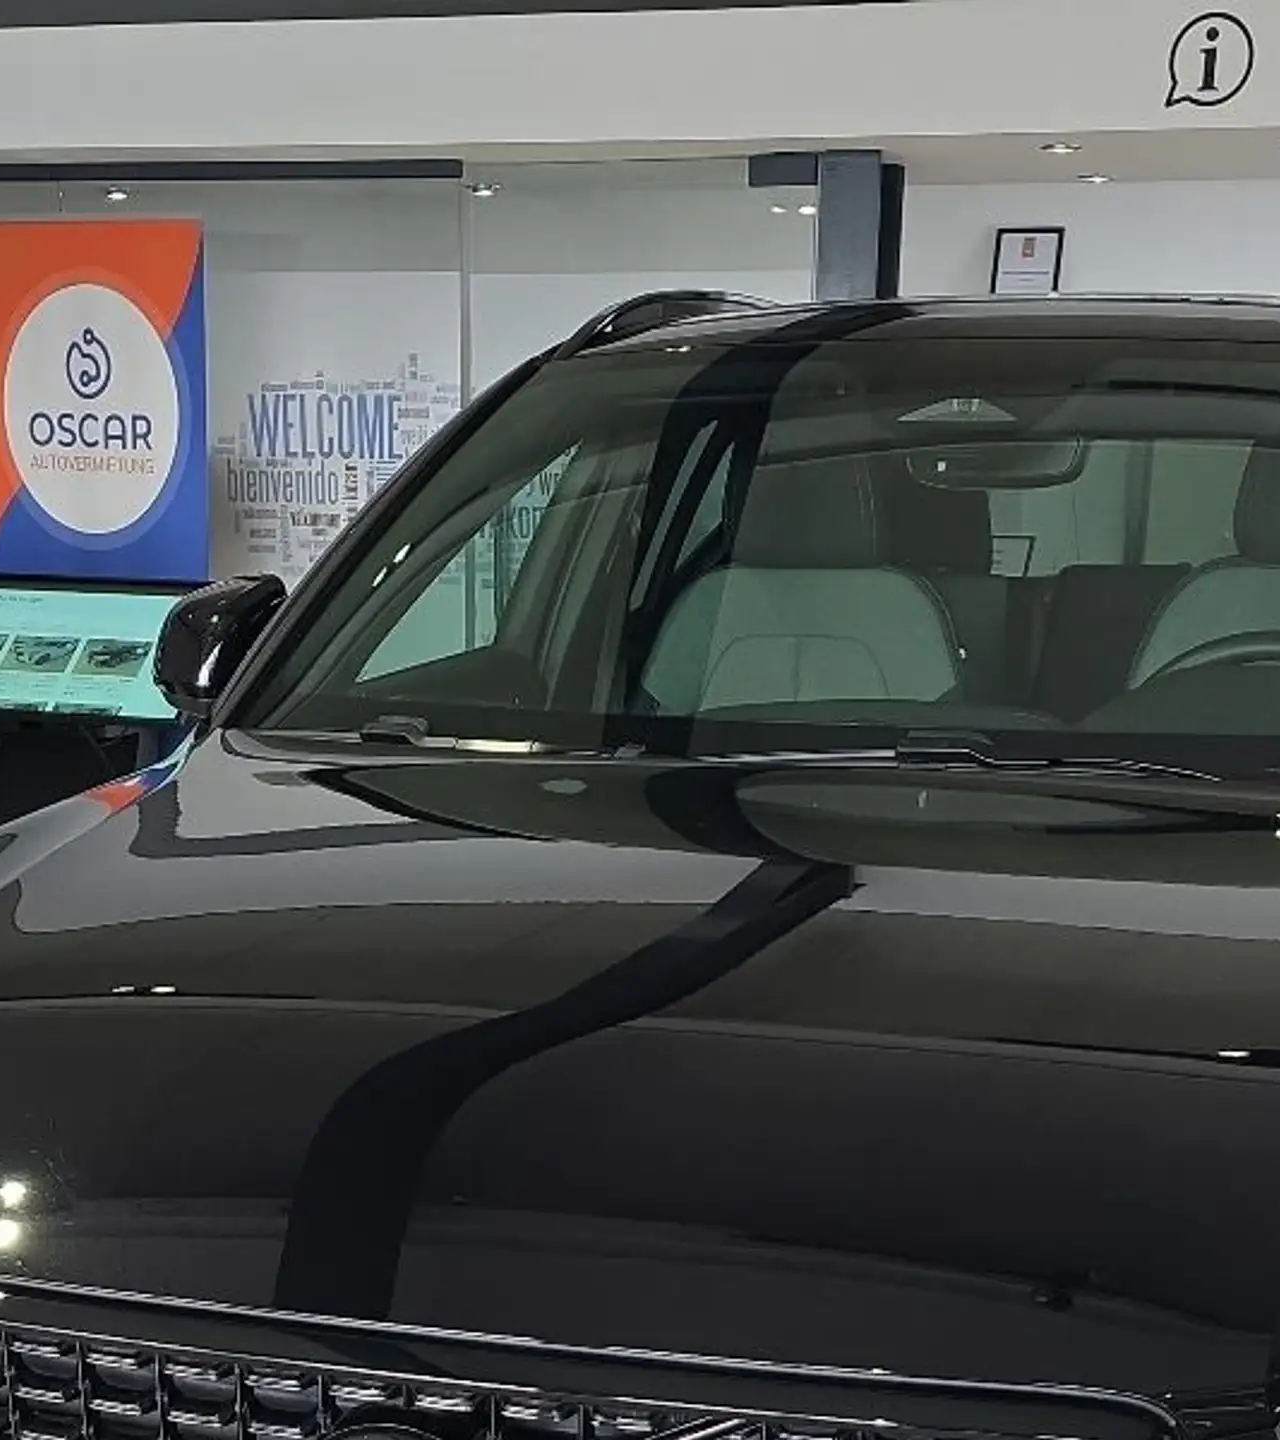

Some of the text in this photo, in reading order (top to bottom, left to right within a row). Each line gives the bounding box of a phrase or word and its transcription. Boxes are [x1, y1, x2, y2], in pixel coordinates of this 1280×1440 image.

[29, 412, 152, 450] OSCAR
[247, 393, 404, 460] WELCOME
[227, 459, 339, 504] bienvenido
